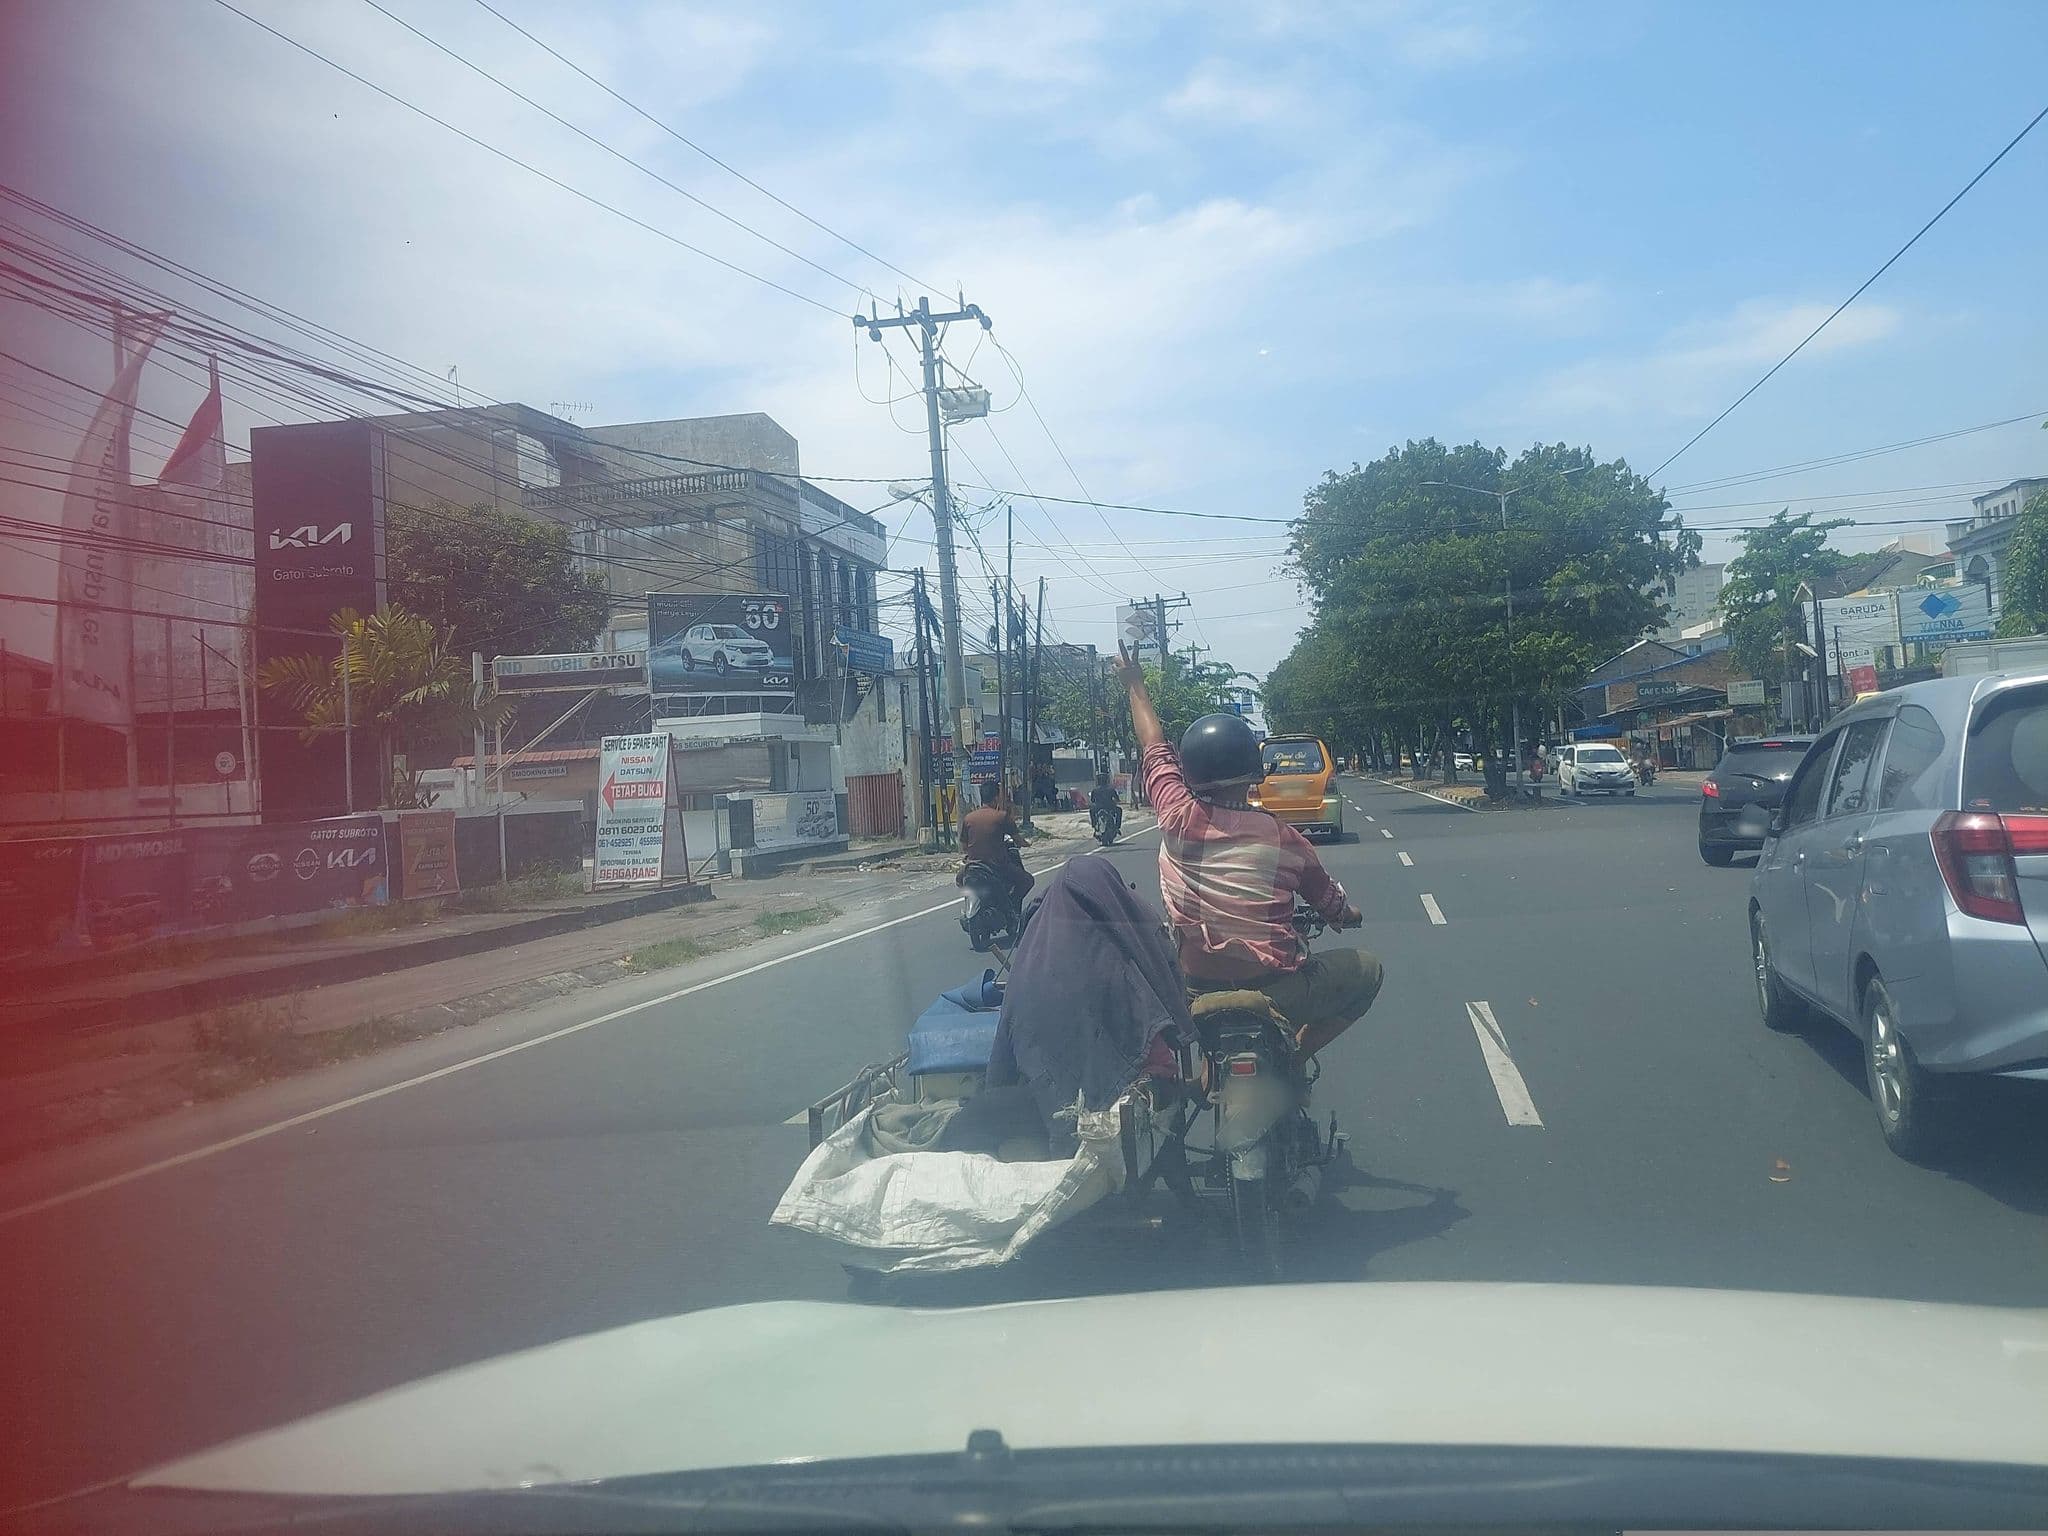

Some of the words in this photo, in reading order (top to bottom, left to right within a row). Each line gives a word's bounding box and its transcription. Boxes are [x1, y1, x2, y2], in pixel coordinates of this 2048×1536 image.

[269, 523, 353, 550] KIA
[1840, 603, 1887, 615] GARUDA
[1127, 643, 1158, 651] SZUKI
[590, 655, 635, 667] GATSU
[763, 676, 788, 684] KIA
[604, 738, 626, 752] SERVICE
[632, 737, 651, 750] SPARE
[652, 735, 667, 749] PART
[621, 755, 654, 764] NISSAN
[620, 767, 653, 776] DATSUN
[611, 783, 637, 798] TETAP
[637, 781, 662, 797] BUKA
[310, 829, 337, 841] GATOT
[339, 827, 378, 839] SUBROTO
[598, 827, 620, 836] 0811
[621, 825, 645, 835] 6023
[327, 847, 377, 869] KIA
[599, 867, 659, 879] BERGARANSI
